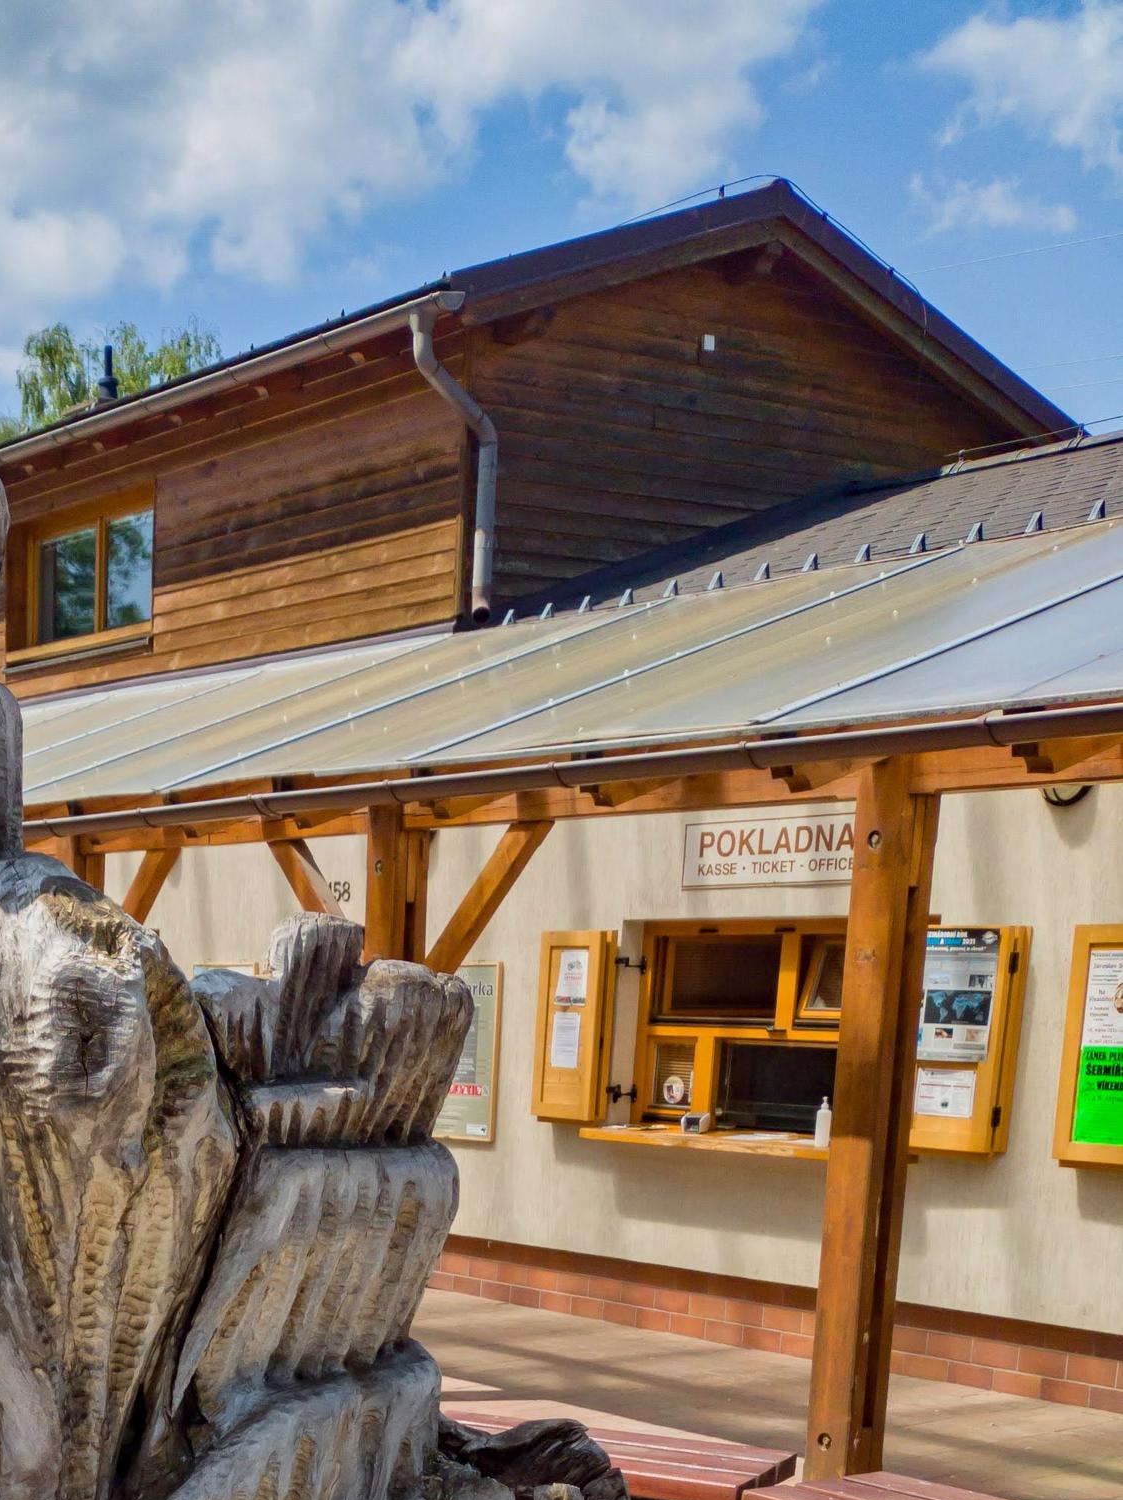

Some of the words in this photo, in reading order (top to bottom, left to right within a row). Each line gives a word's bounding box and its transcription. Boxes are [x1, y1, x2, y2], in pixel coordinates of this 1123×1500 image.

[699, 823, 855, 858] POKLADNA
[697, 863, 738, 876] KASSE
[751, 860, 796, 874] TICKET
[808, 857, 854, 872] OFFICE
